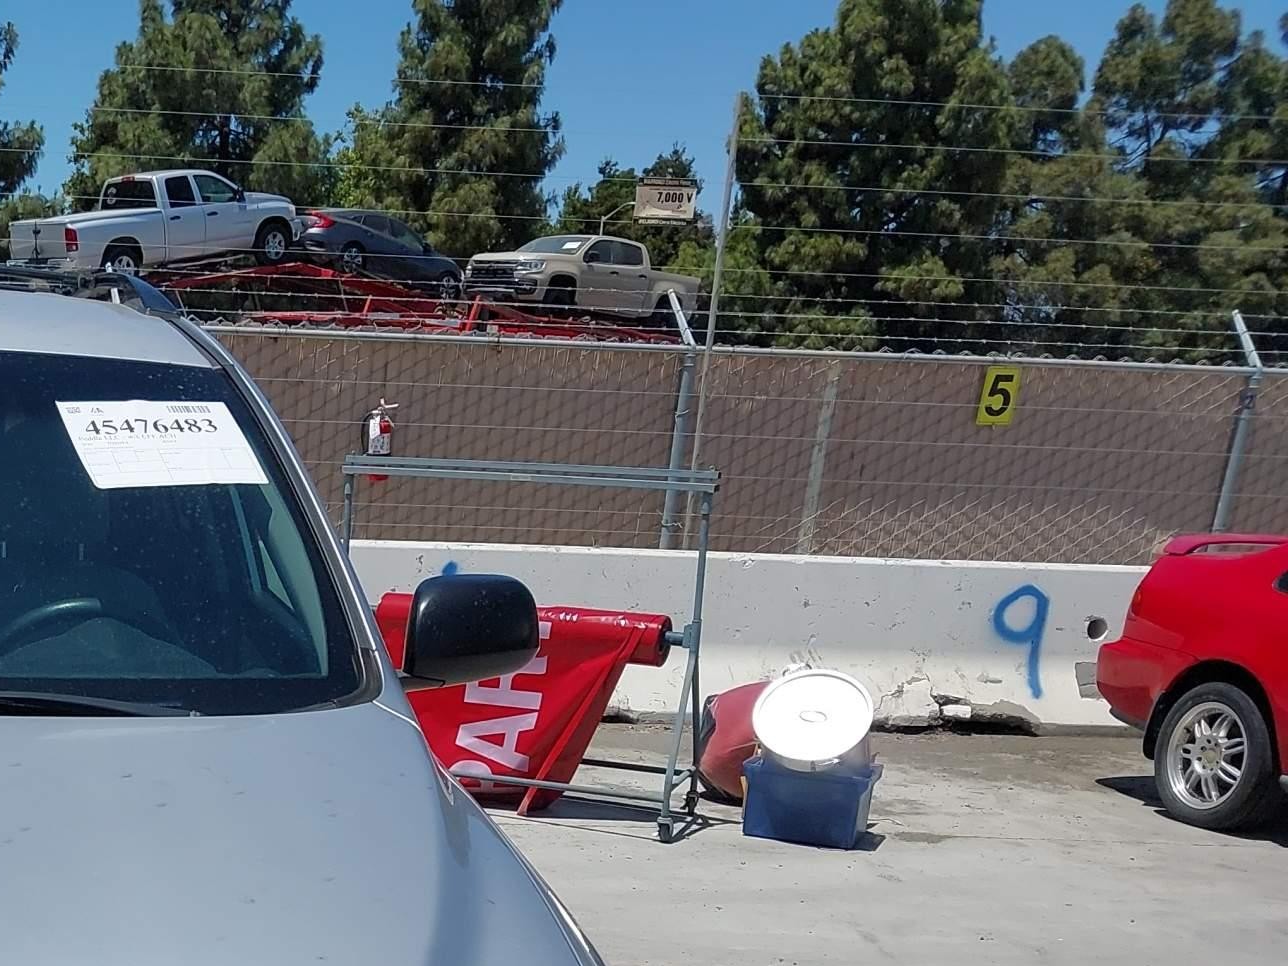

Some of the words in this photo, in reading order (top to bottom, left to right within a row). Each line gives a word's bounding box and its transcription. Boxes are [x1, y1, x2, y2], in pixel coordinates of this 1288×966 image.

[657, 192, 684, 204] 7,000
[687, 193, 694, 203] V
[985, 374, 1015, 417] 5
[85, 418, 218, 435] 45476483
[993, 584, 1050, 699] 9
